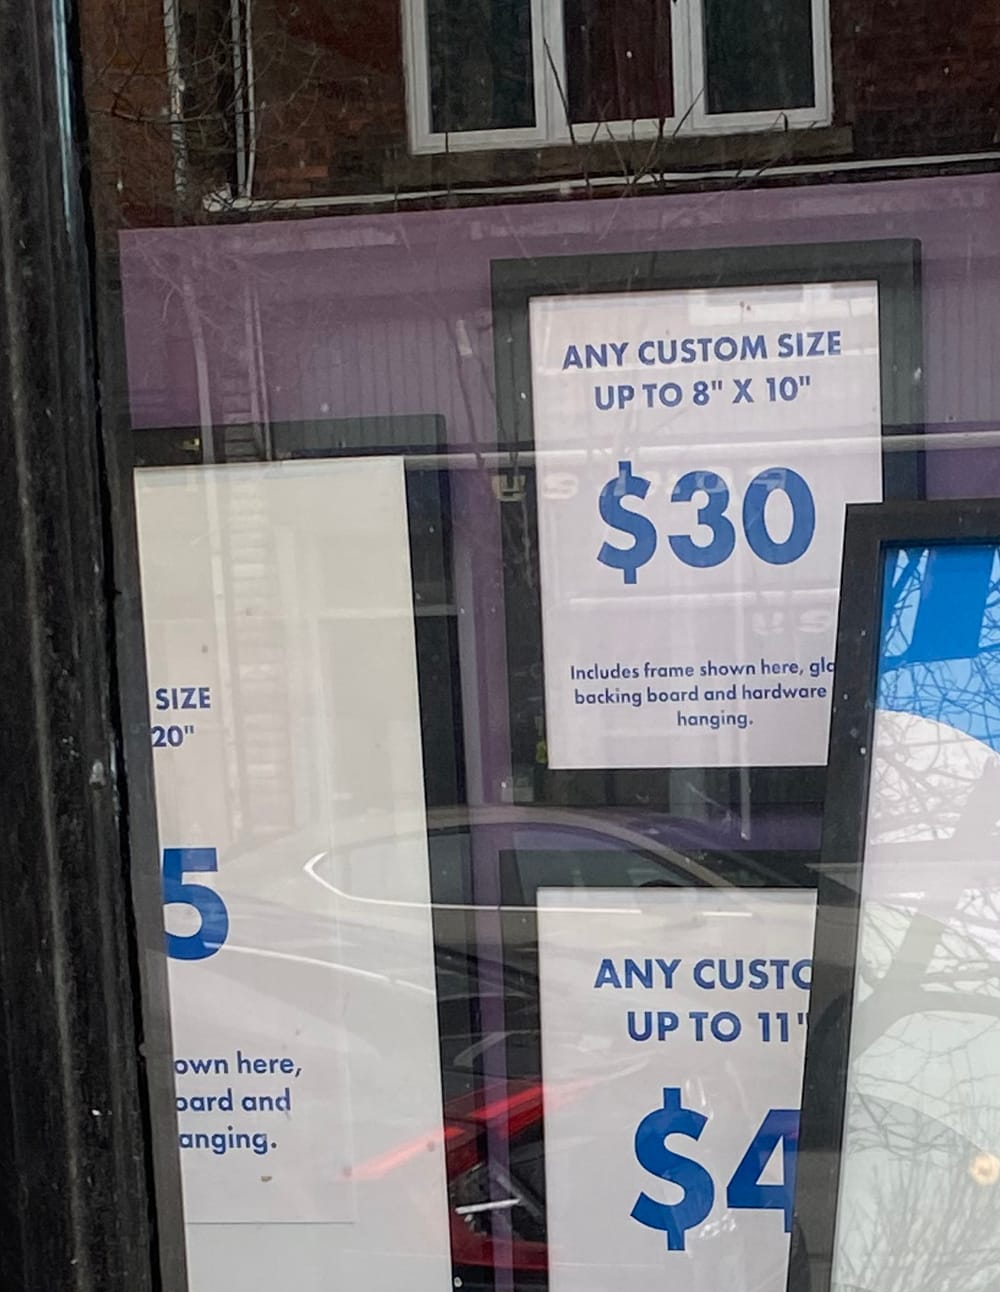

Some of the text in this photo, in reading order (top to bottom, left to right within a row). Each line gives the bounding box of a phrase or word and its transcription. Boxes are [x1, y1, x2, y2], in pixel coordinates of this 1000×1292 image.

[562, 330, 841, 369] ANY CUSTOM SIZE
[594, 376, 811, 410] UP TO 8" X 10"
[597, 461, 816, 584] $30
[570, 663, 639, 681] Includes
[644, 661, 694, 679] frame
[700, 660, 756, 677] shown
[761, 658, 804, 677] here,
[155, 687, 211, 710] SIZE
[574, 682, 827, 707] backing board and hardware
[677, 708, 754, 729] hanging.
[594, 959, 681, 989] ANY
[627, 1011, 678, 1042] UP
[690, 1012, 741, 1042] TO
[236, 1051, 302, 1077] here,
[241, 1087, 291, 1111] and
[178, 1126, 277, 1154] anging.
[630, 1087, 802, 1251] $4
